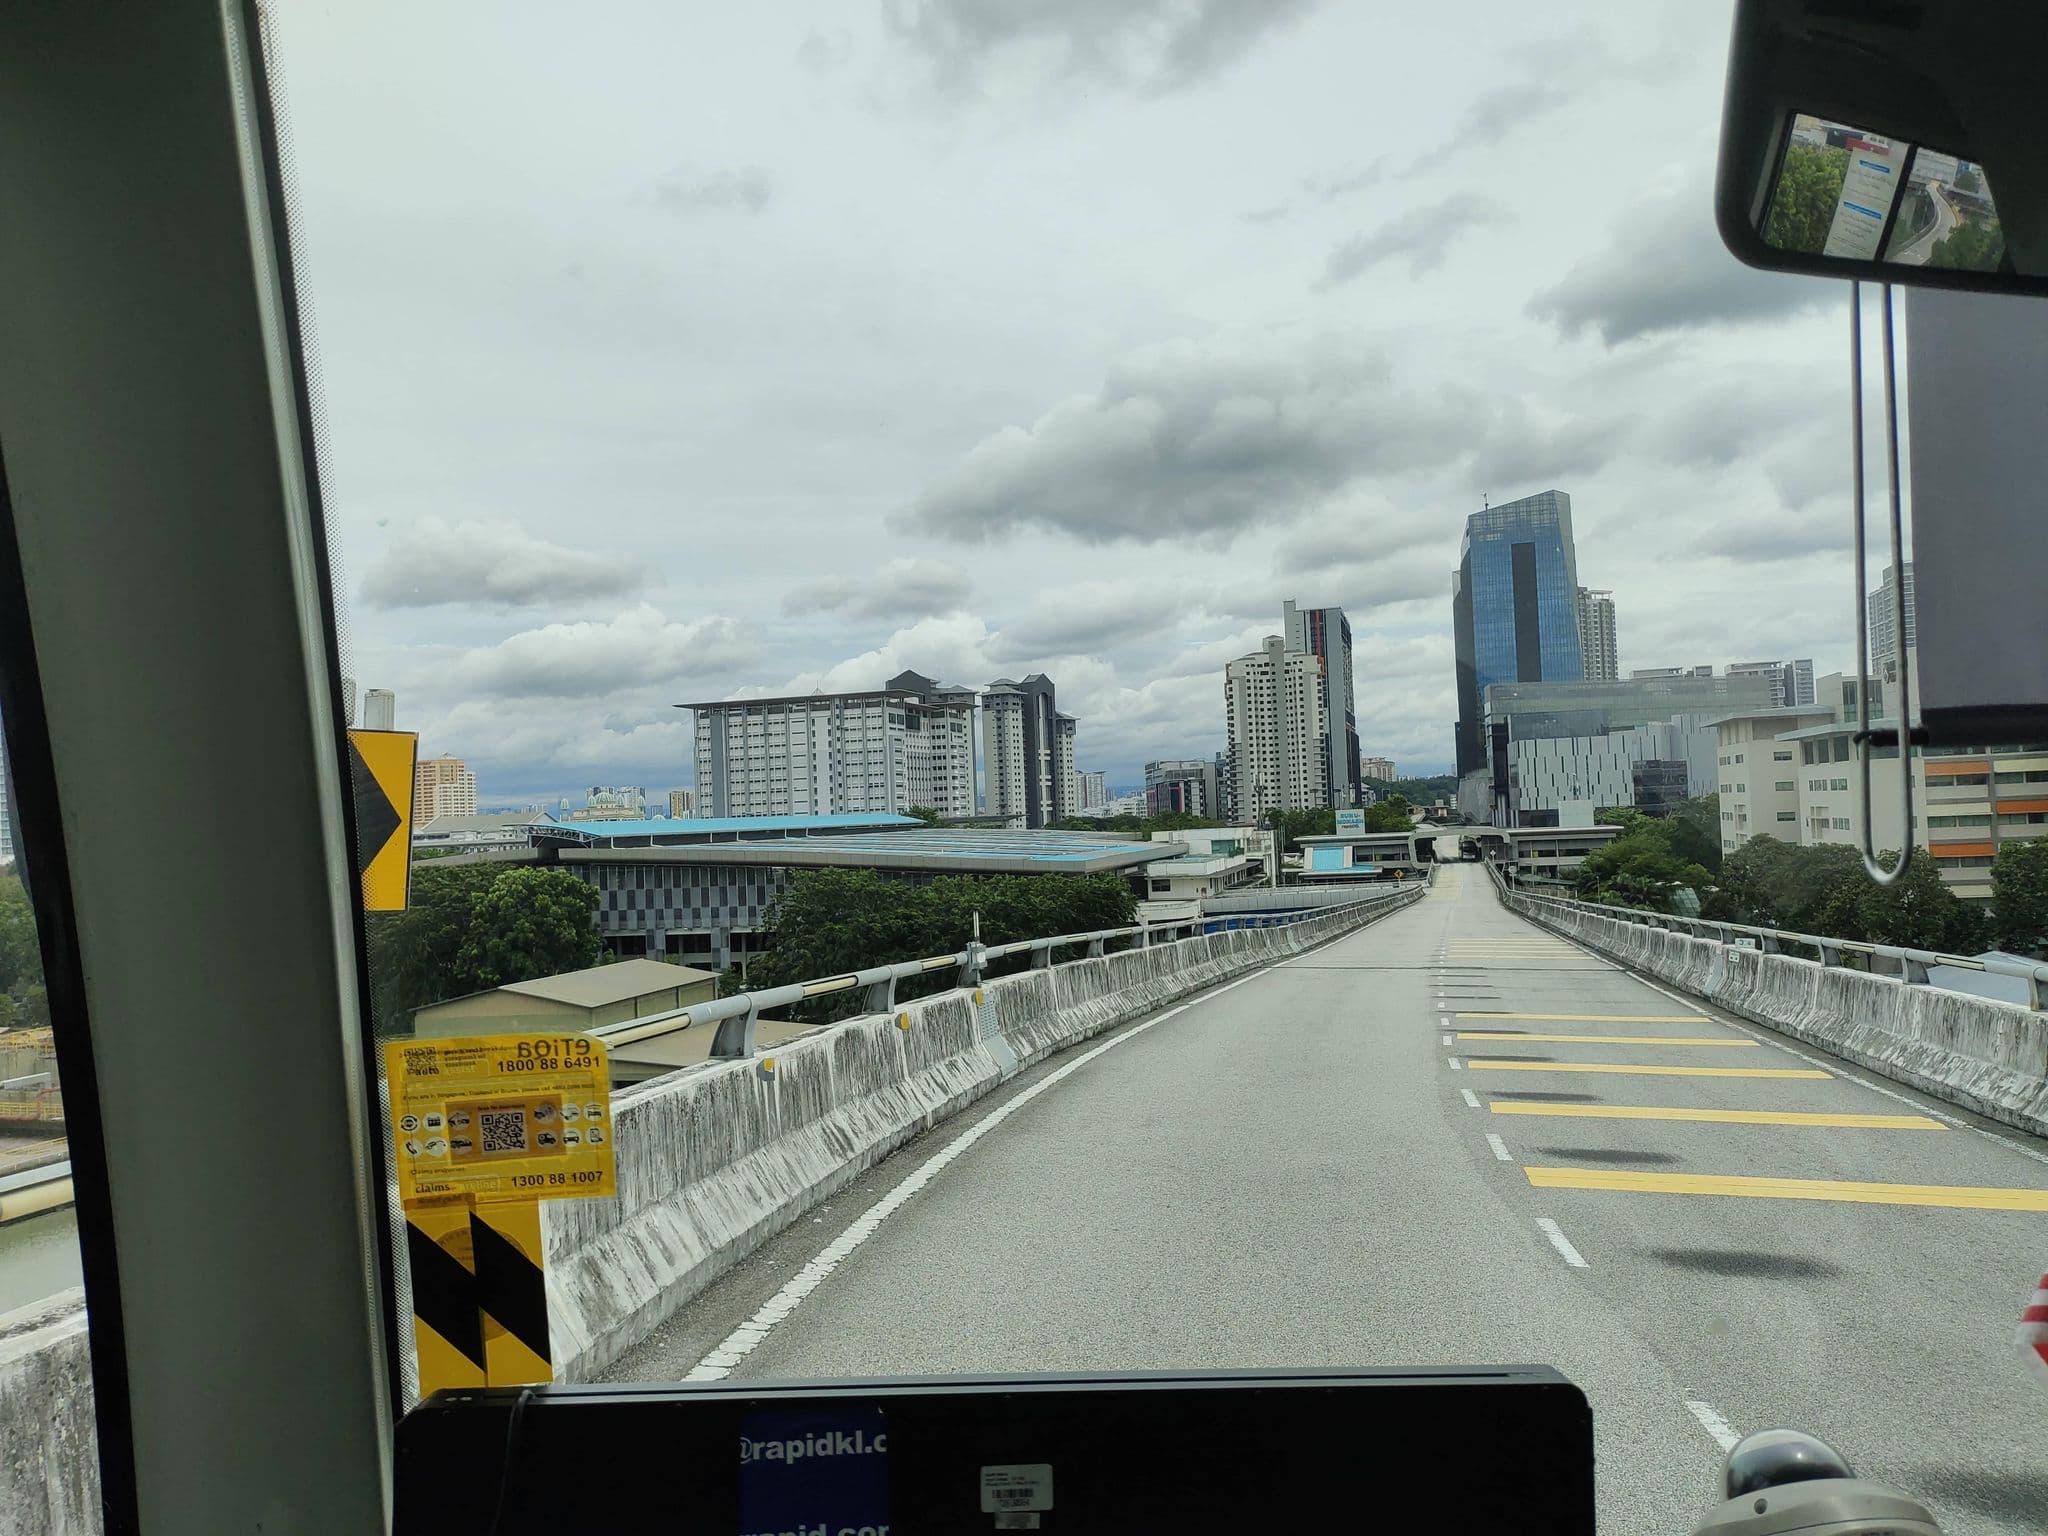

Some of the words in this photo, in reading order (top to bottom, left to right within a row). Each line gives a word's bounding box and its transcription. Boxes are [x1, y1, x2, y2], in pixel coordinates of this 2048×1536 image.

[498, 1058, 534, 1073] 1800
[540, 1057, 560, 1071] 88
[564, 1055, 601, 1070] 6491
[511, 1175, 544, 1188] 1300
[549, 1173, 566, 1185] 88
[572, 1171, 604, 1183] 1007
[415, 1183, 450, 1194] claims
